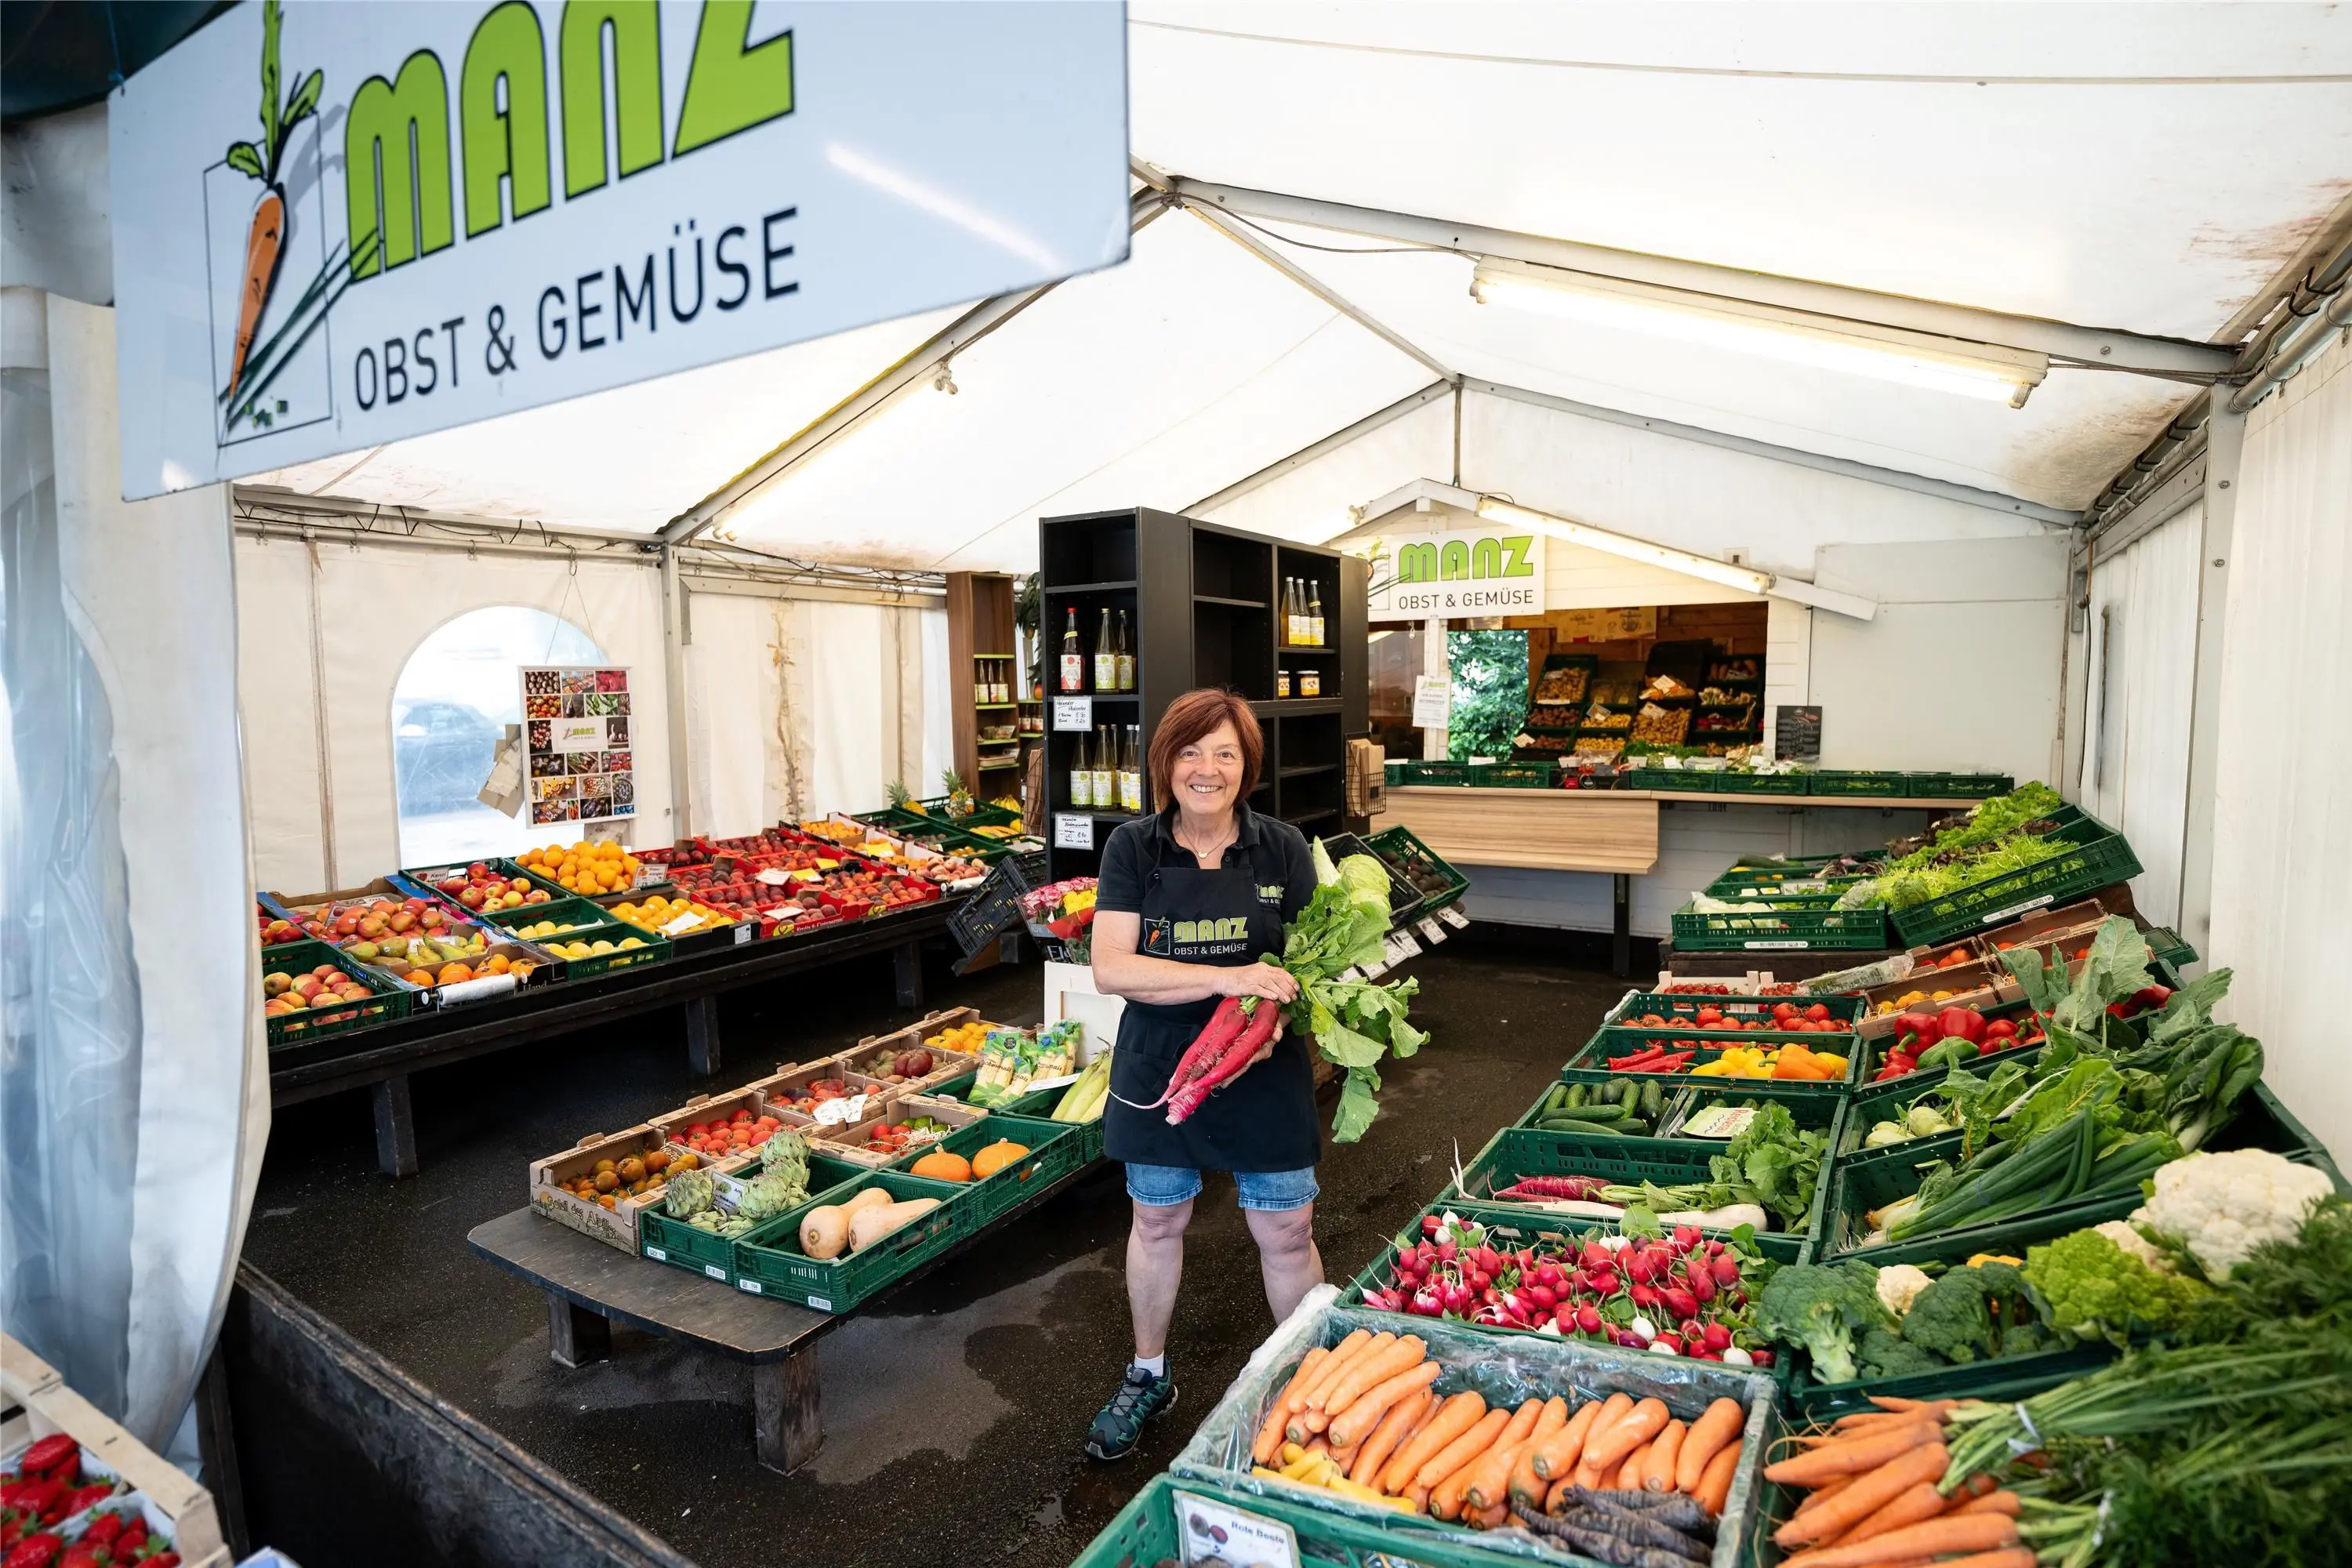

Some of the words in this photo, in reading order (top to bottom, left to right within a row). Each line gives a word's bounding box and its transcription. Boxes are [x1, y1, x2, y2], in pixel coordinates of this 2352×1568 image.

[346, 0, 795, 283] MANZ
[355, 316, 465, 412] OBST
[485, 304, 518, 377] &
[538, 206, 800, 360] GEMÜSE
[1399, 536, 1534, 583] MANZ
[1399, 594, 1440, 610] OBST
[1446, 593, 1456, 608] &
[1463, 587, 1534, 607] GEMÜSE
[1174, 917, 1248, 943] MANZ
[1174, 946, 1199, 955] OBST
[1210, 942, 1248, 954] GEMÜSE
[547, 1196, 568, 1211] Soleil
[571, 1203, 583, 1220] des
[1232, 1520, 1254, 1535] Rote
